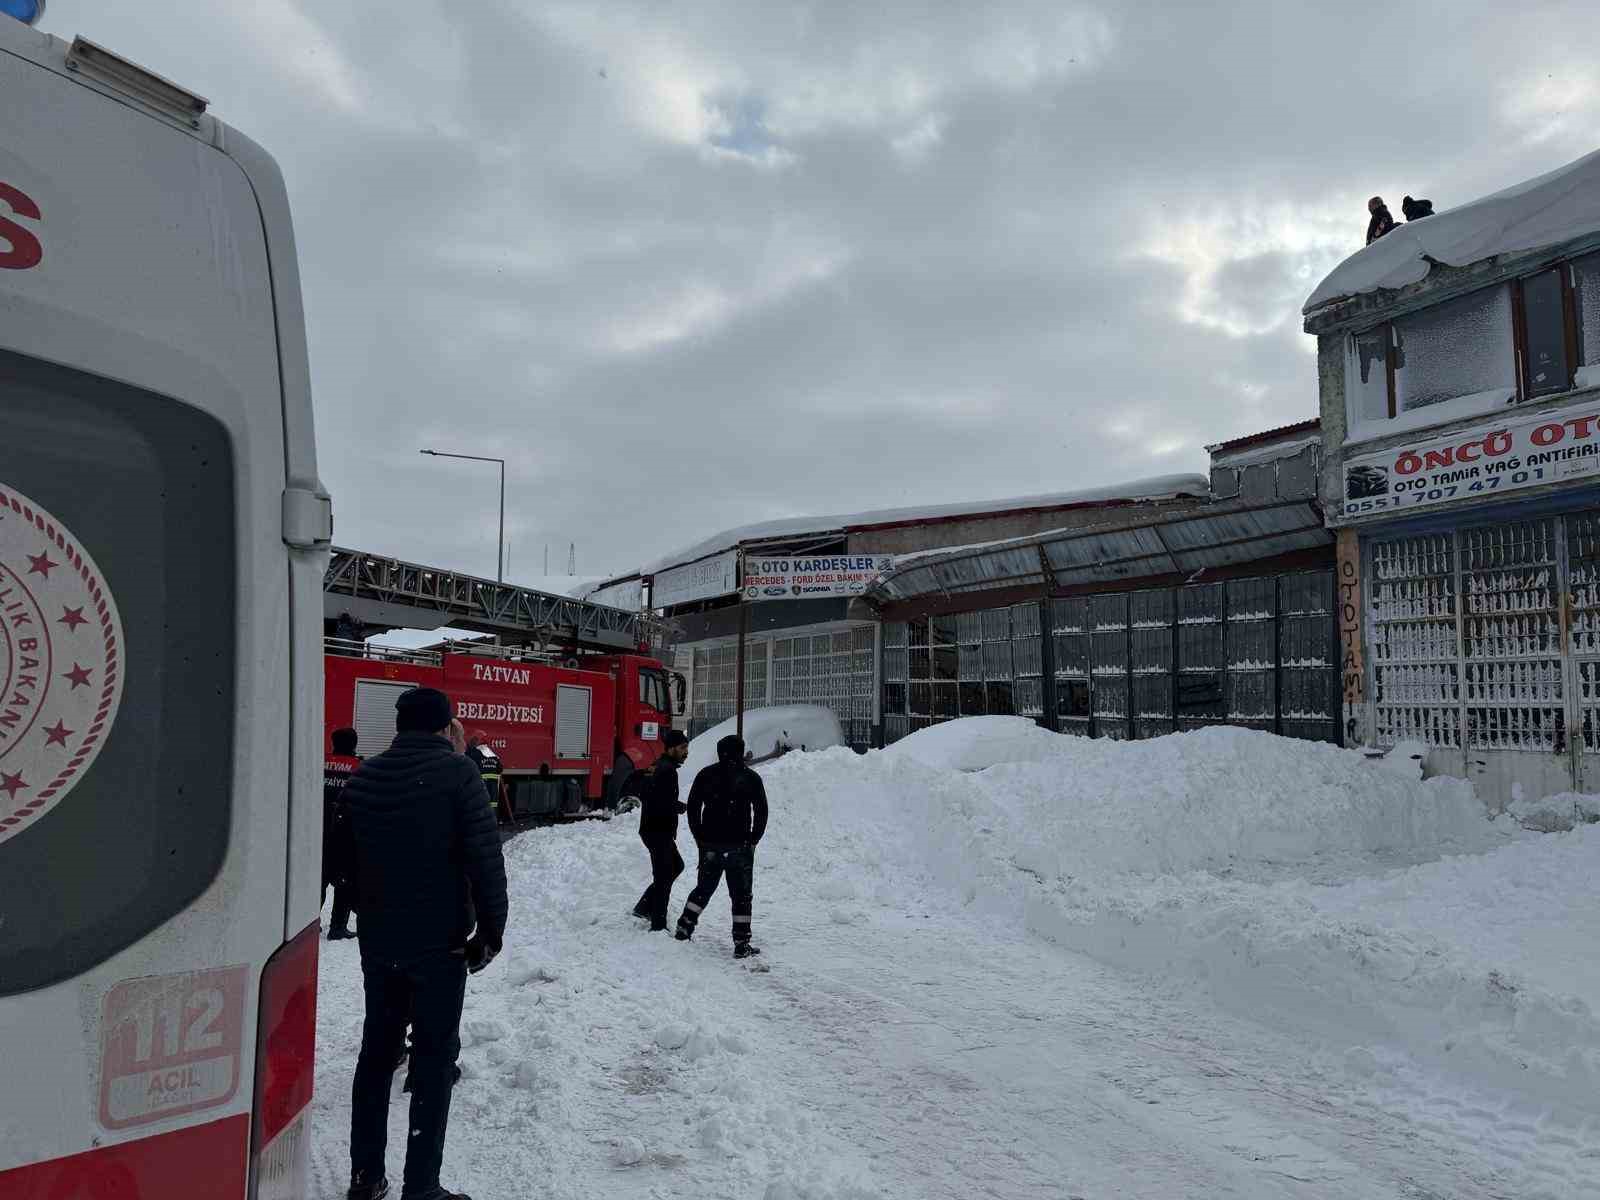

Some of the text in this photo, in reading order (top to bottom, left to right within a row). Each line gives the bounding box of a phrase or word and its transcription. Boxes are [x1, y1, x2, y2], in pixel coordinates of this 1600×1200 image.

[1394, 414, 1600, 475] ÖNCÜ OT
[1394, 475, 1428, 493] OTO
[1484, 454, 1521, 478] YAĞ
[1526, 442, 1600, 467] ANTİFİRİ
[1346, 495, 1400, 513] 0551
[1412, 485, 1458, 503] 707
[1468, 476, 1502, 492] 47
[745, 575, 786, 586] MERCEDES
[792, 574, 813, 585] FORD
[761, 560, 789, 573] OTO
[472, 663, 531, 685] TATVAN
[456, 702, 543, 724] BELEDİYESİ
[129, 990, 225, 1063] 112
